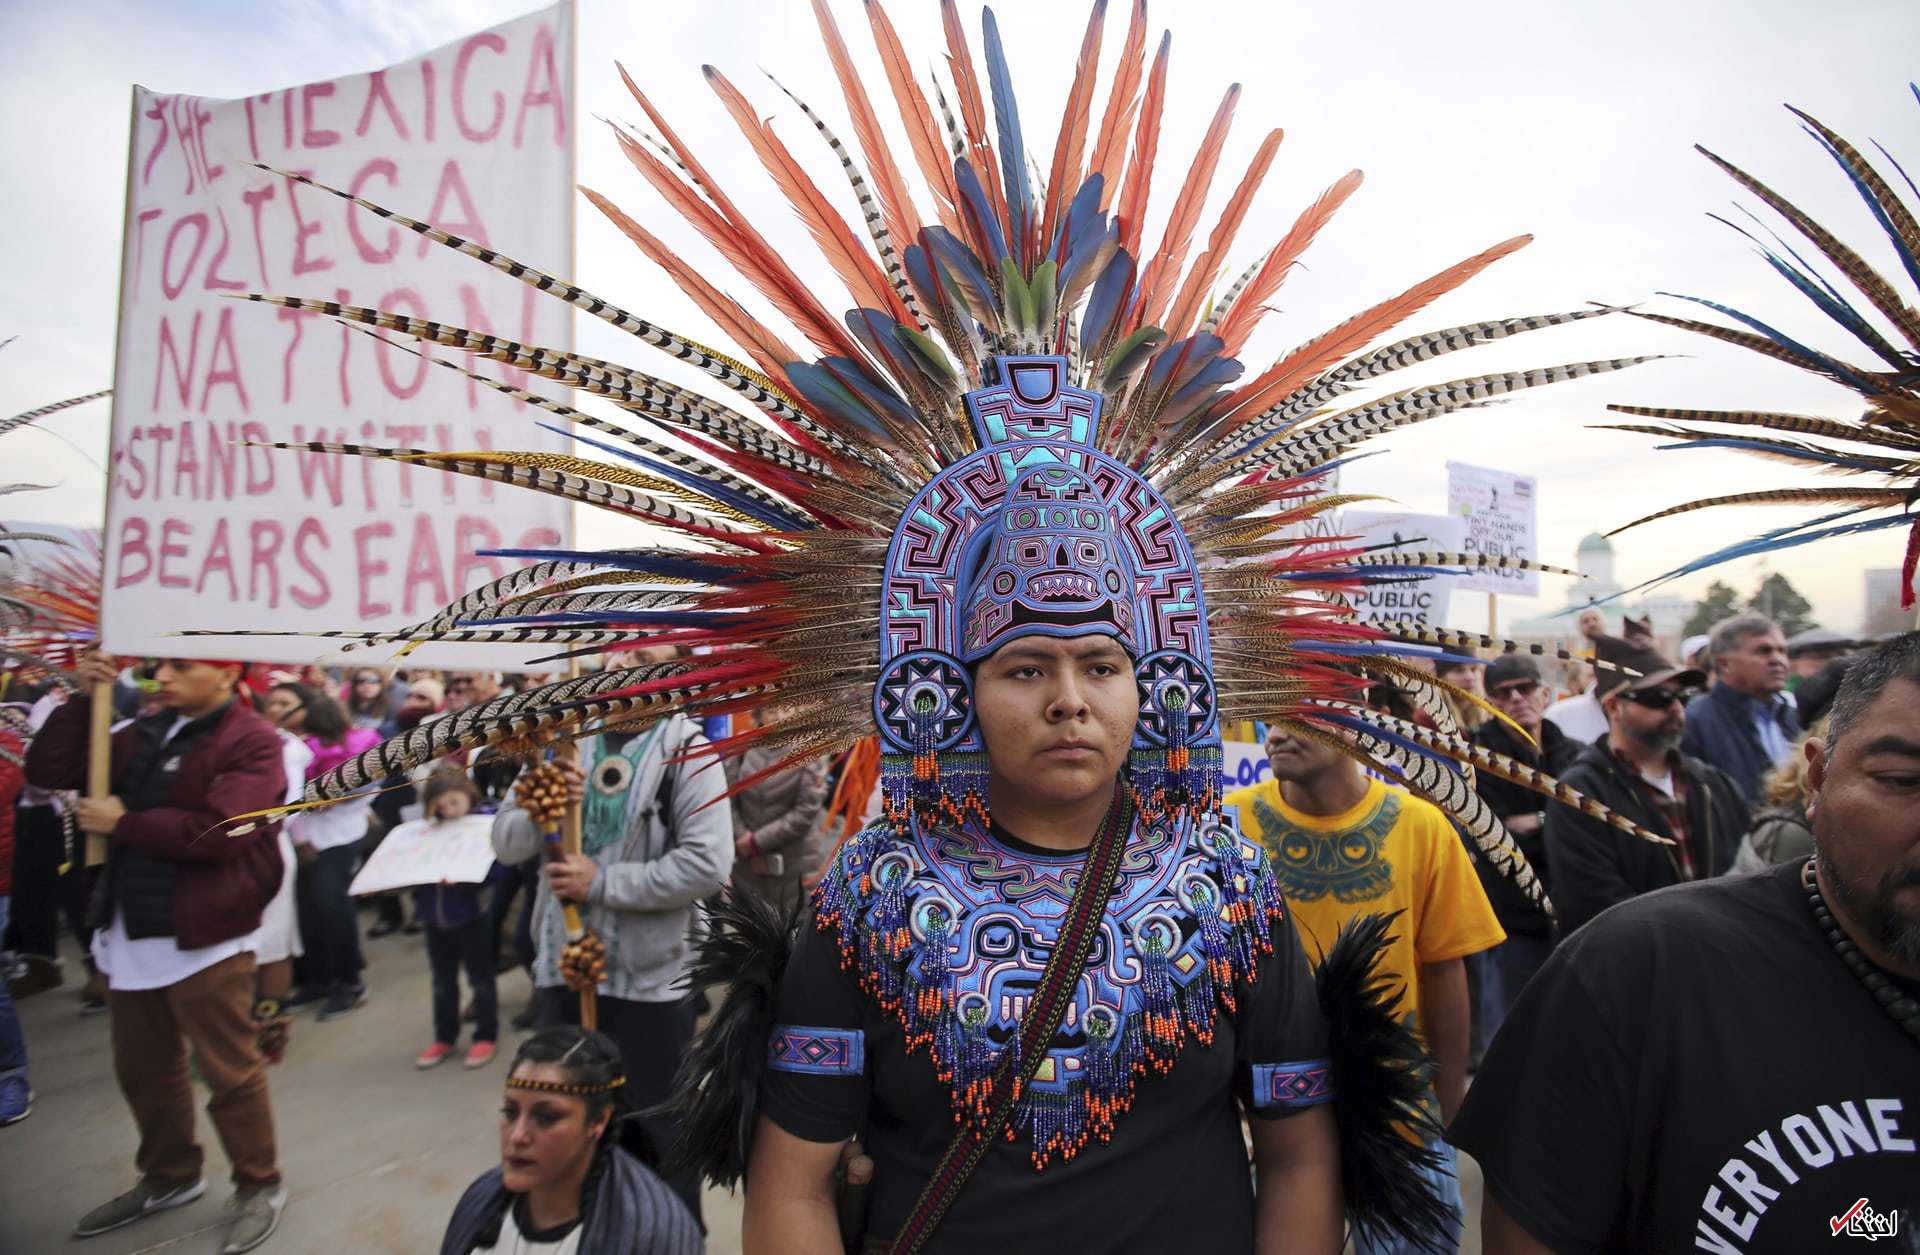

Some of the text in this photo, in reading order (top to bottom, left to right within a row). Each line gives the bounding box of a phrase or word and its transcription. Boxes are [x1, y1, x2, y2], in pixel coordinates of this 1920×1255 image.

[144, 23, 567, 194] THE MEXICA
[126, 420, 276, 501] STAND
[115, 515, 332, 609] BEARS
[1465, 537, 1527, 559] PUBLIC
[1354, 591, 1432, 609] PUBLIC
[1368, 611, 1428, 625] ANDS
